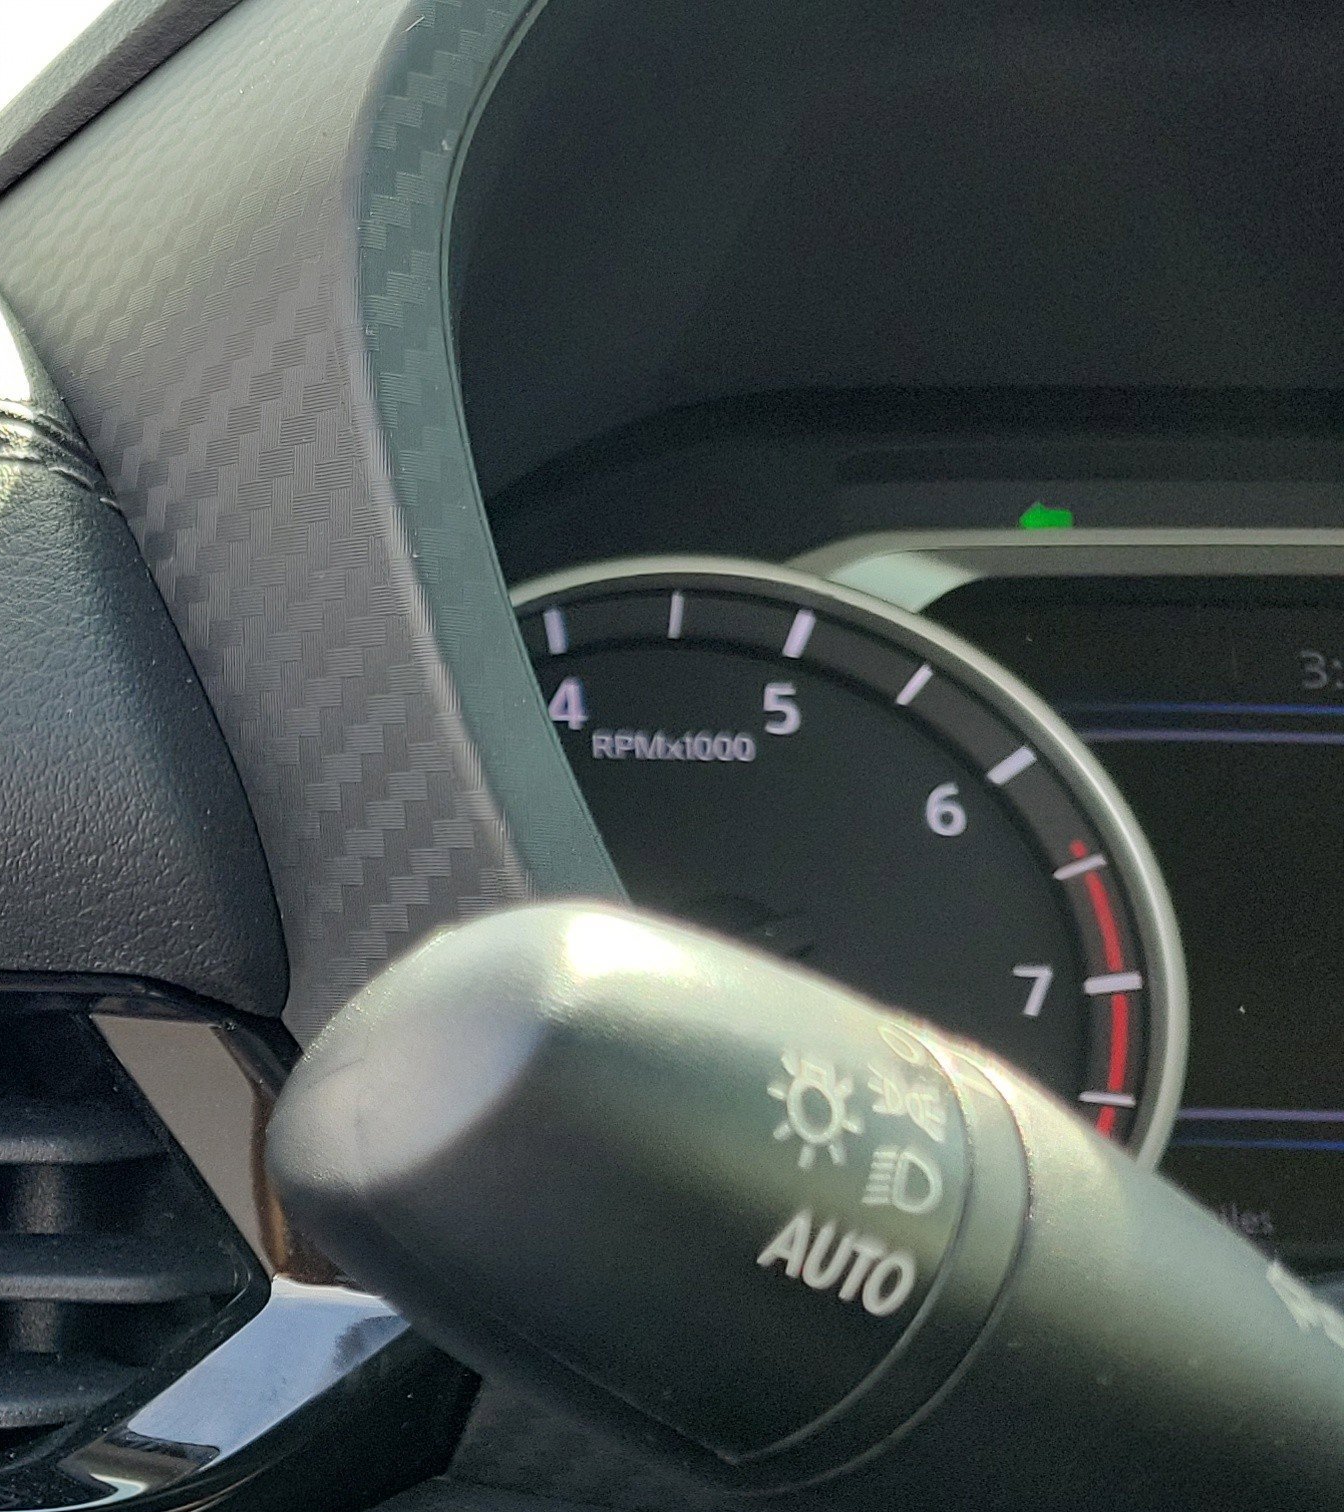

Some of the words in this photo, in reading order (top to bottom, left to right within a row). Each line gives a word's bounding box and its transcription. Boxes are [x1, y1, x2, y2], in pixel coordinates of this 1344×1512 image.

[548, 676, 588, 730] 4
[763, 681, 802, 735] 5
[591, 730, 756, 762] RPMx1000
[925, 782, 968, 836] 6
[1012, 964, 1053, 1017] 7
[756, 1209, 916, 1317] AUTO
